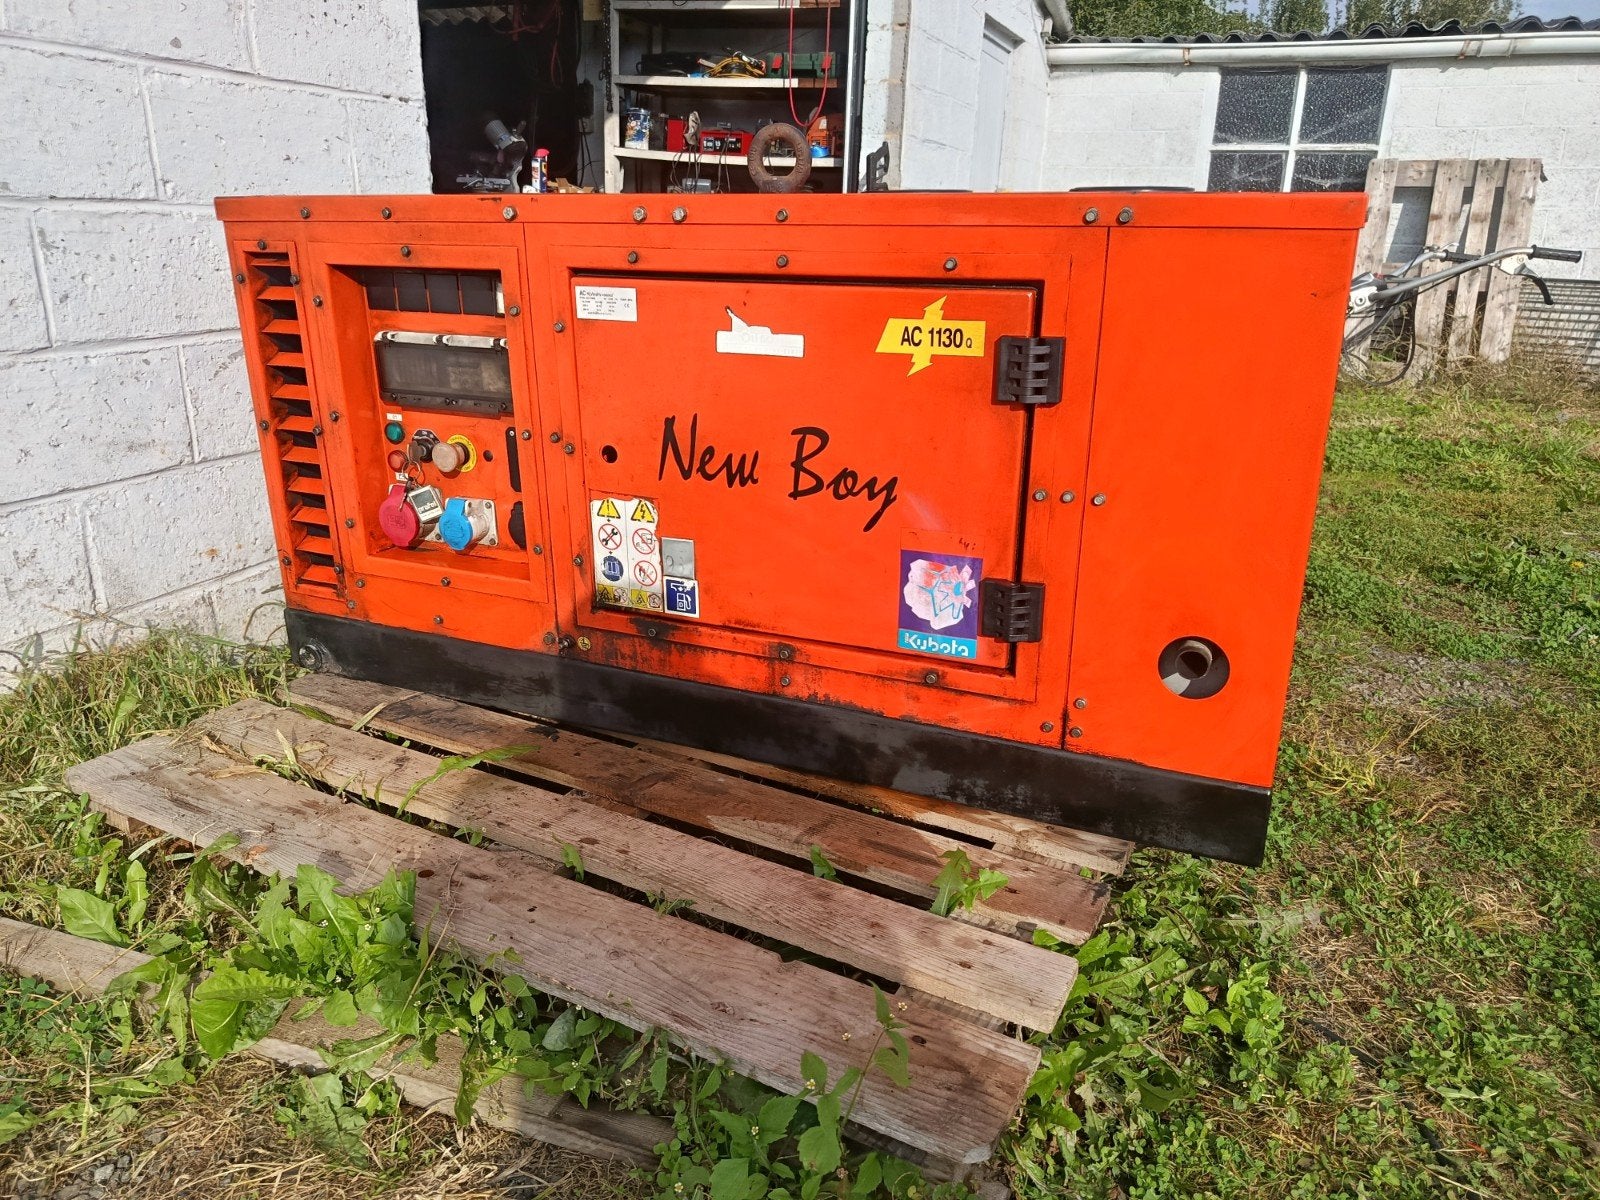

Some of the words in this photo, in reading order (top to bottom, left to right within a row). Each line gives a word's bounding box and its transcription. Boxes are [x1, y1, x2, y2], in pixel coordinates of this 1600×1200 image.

[900, 325, 923, 347] AC
[928, 327, 964, 349] 1130
[965, 337, 973, 349] Q
[658, 413, 759, 488] New
[788, 426, 898, 532] Boy
[904, 632, 969, 657] Kubota
